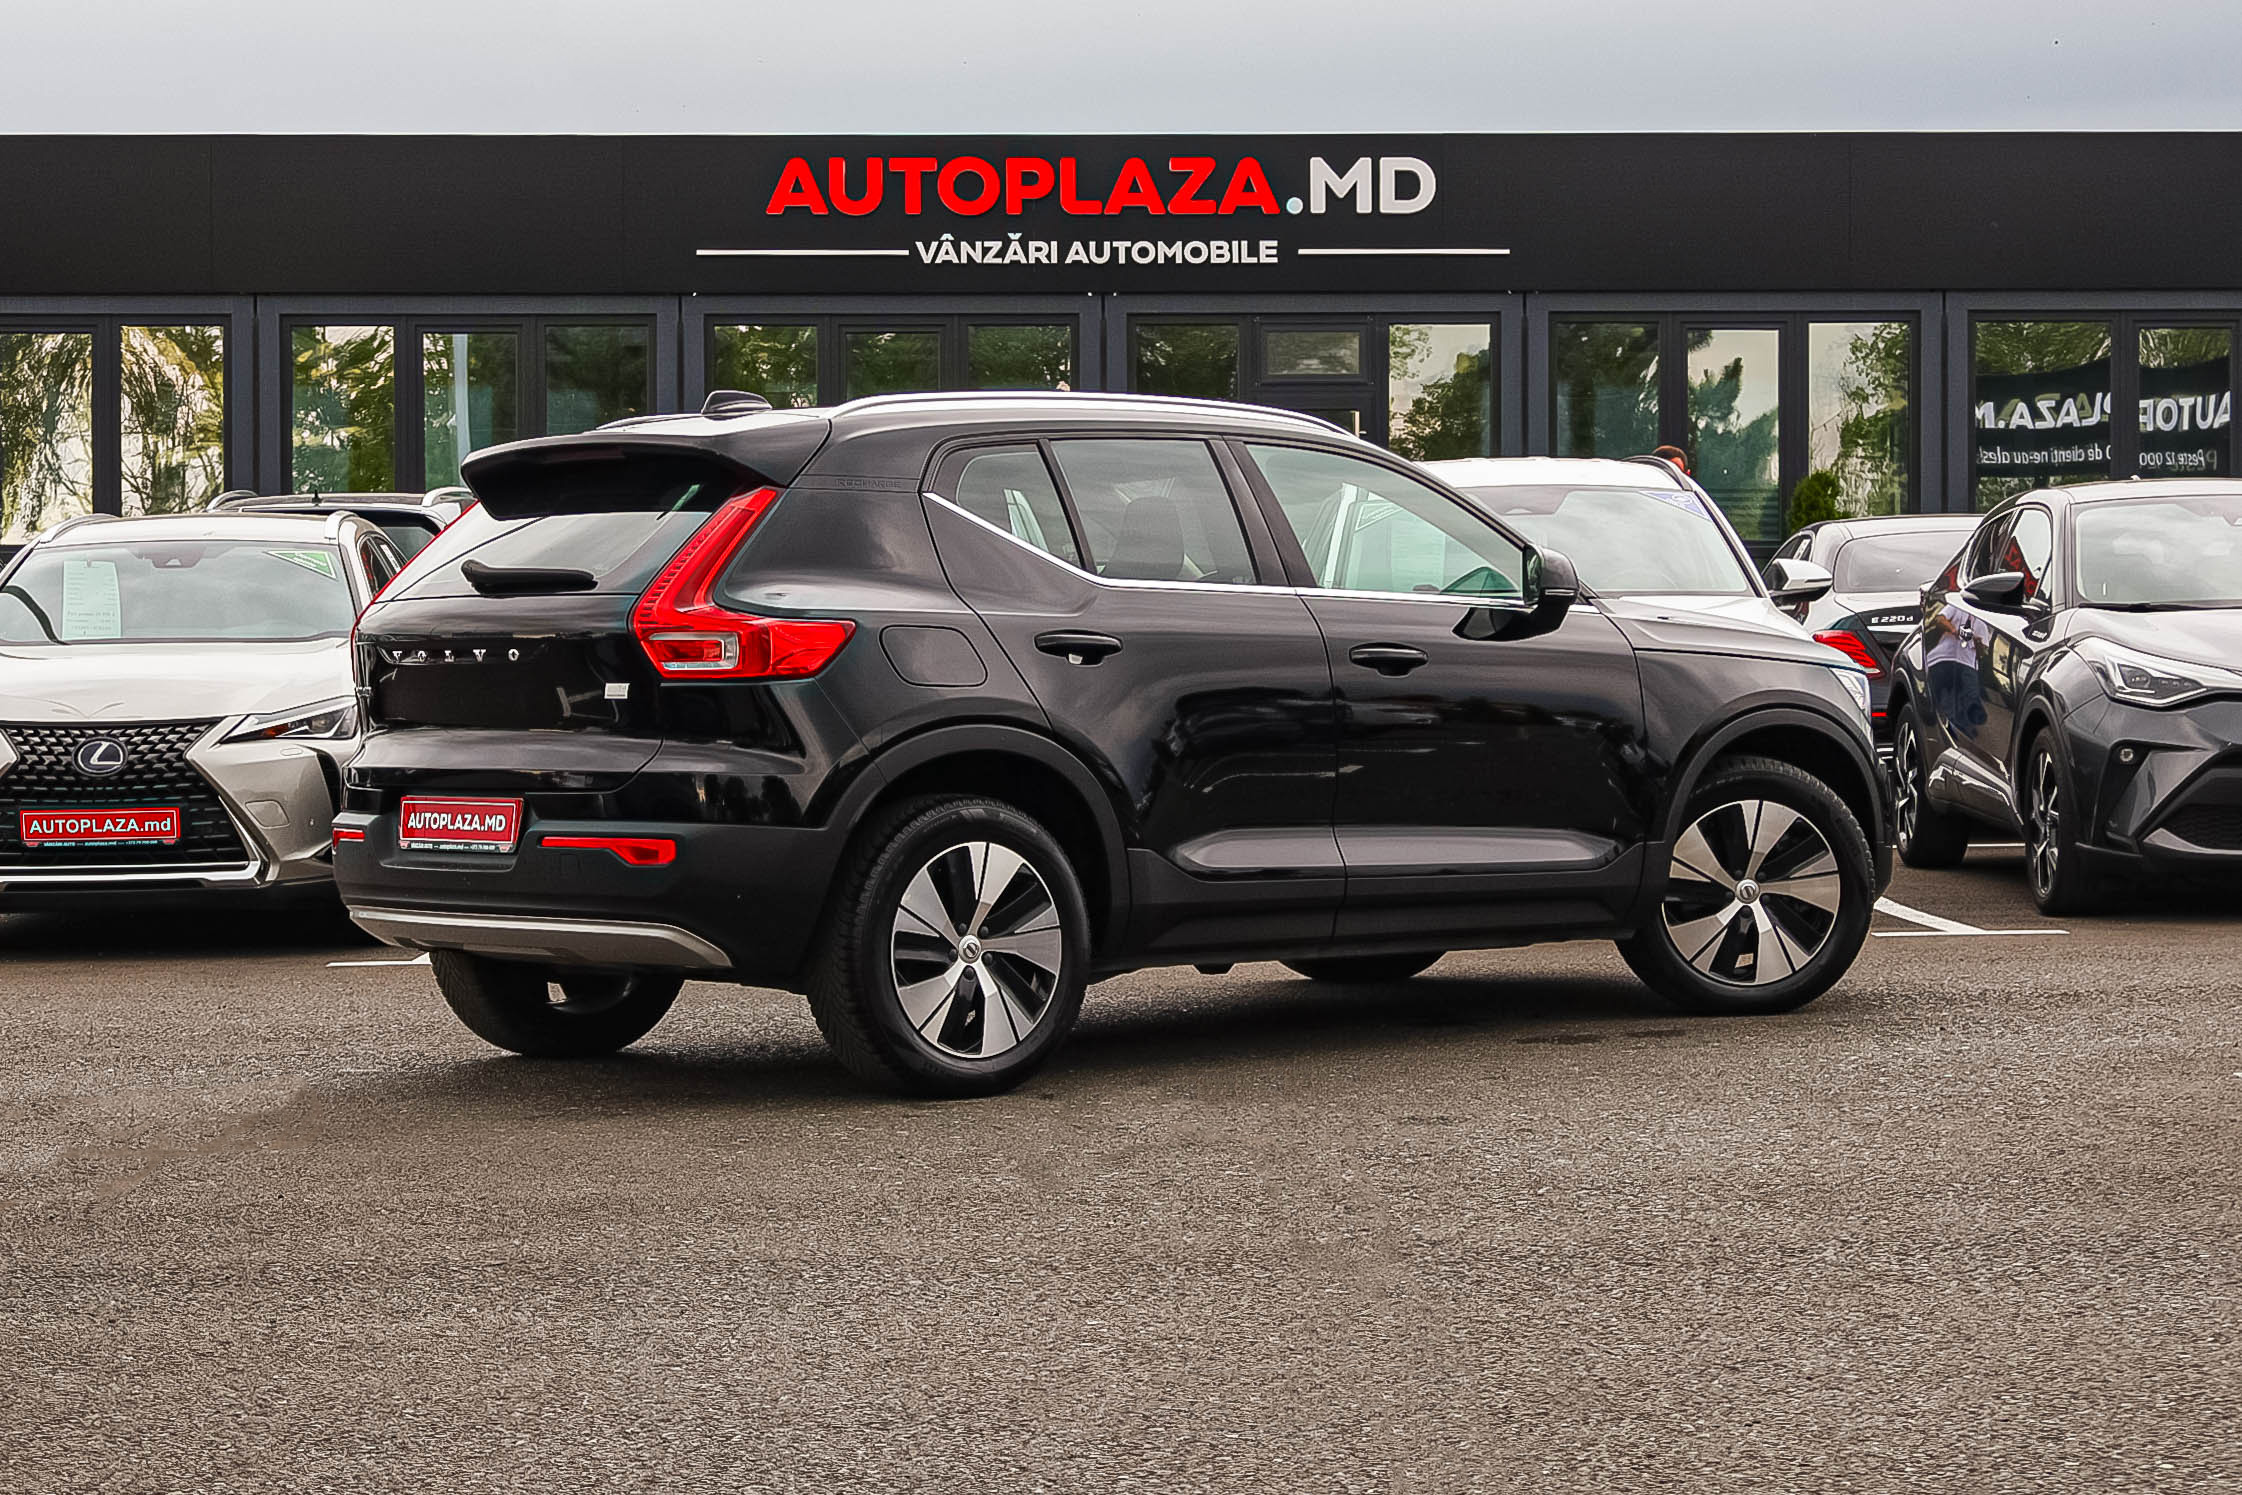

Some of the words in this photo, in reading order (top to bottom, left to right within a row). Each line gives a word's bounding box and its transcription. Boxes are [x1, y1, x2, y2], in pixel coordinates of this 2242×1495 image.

[766, 156, 1436, 215] AUTOPLAZA.MD
[915, 233, 1057, 263] VÂNZĂRI
[1065, 240, 1278, 264] AUTOMOBILE
[392, 648, 520, 663] VOLVO
[30, 818, 171, 833] AUTOPLAZA.md
[408, 813, 506, 831] AUTOPLAZA.MD
